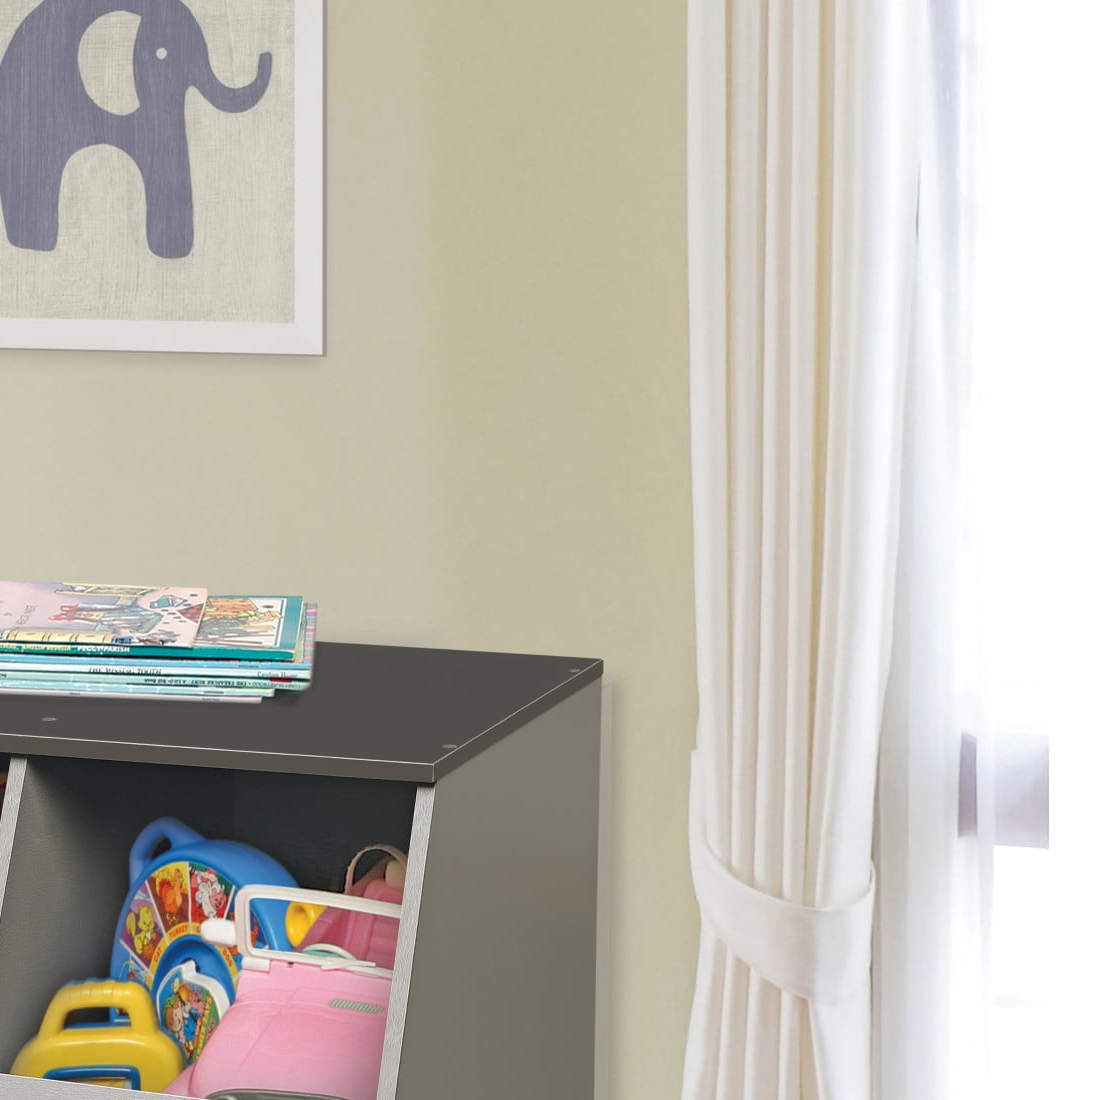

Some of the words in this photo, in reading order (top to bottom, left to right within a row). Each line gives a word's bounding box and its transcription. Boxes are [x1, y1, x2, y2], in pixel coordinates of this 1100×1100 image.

[76, 645, 102, 653] PEGGY
[103, 646, 131, 654] PARISH
[153, 947, 163, 962] CAT
[169, 924, 189, 938] TURKEY
